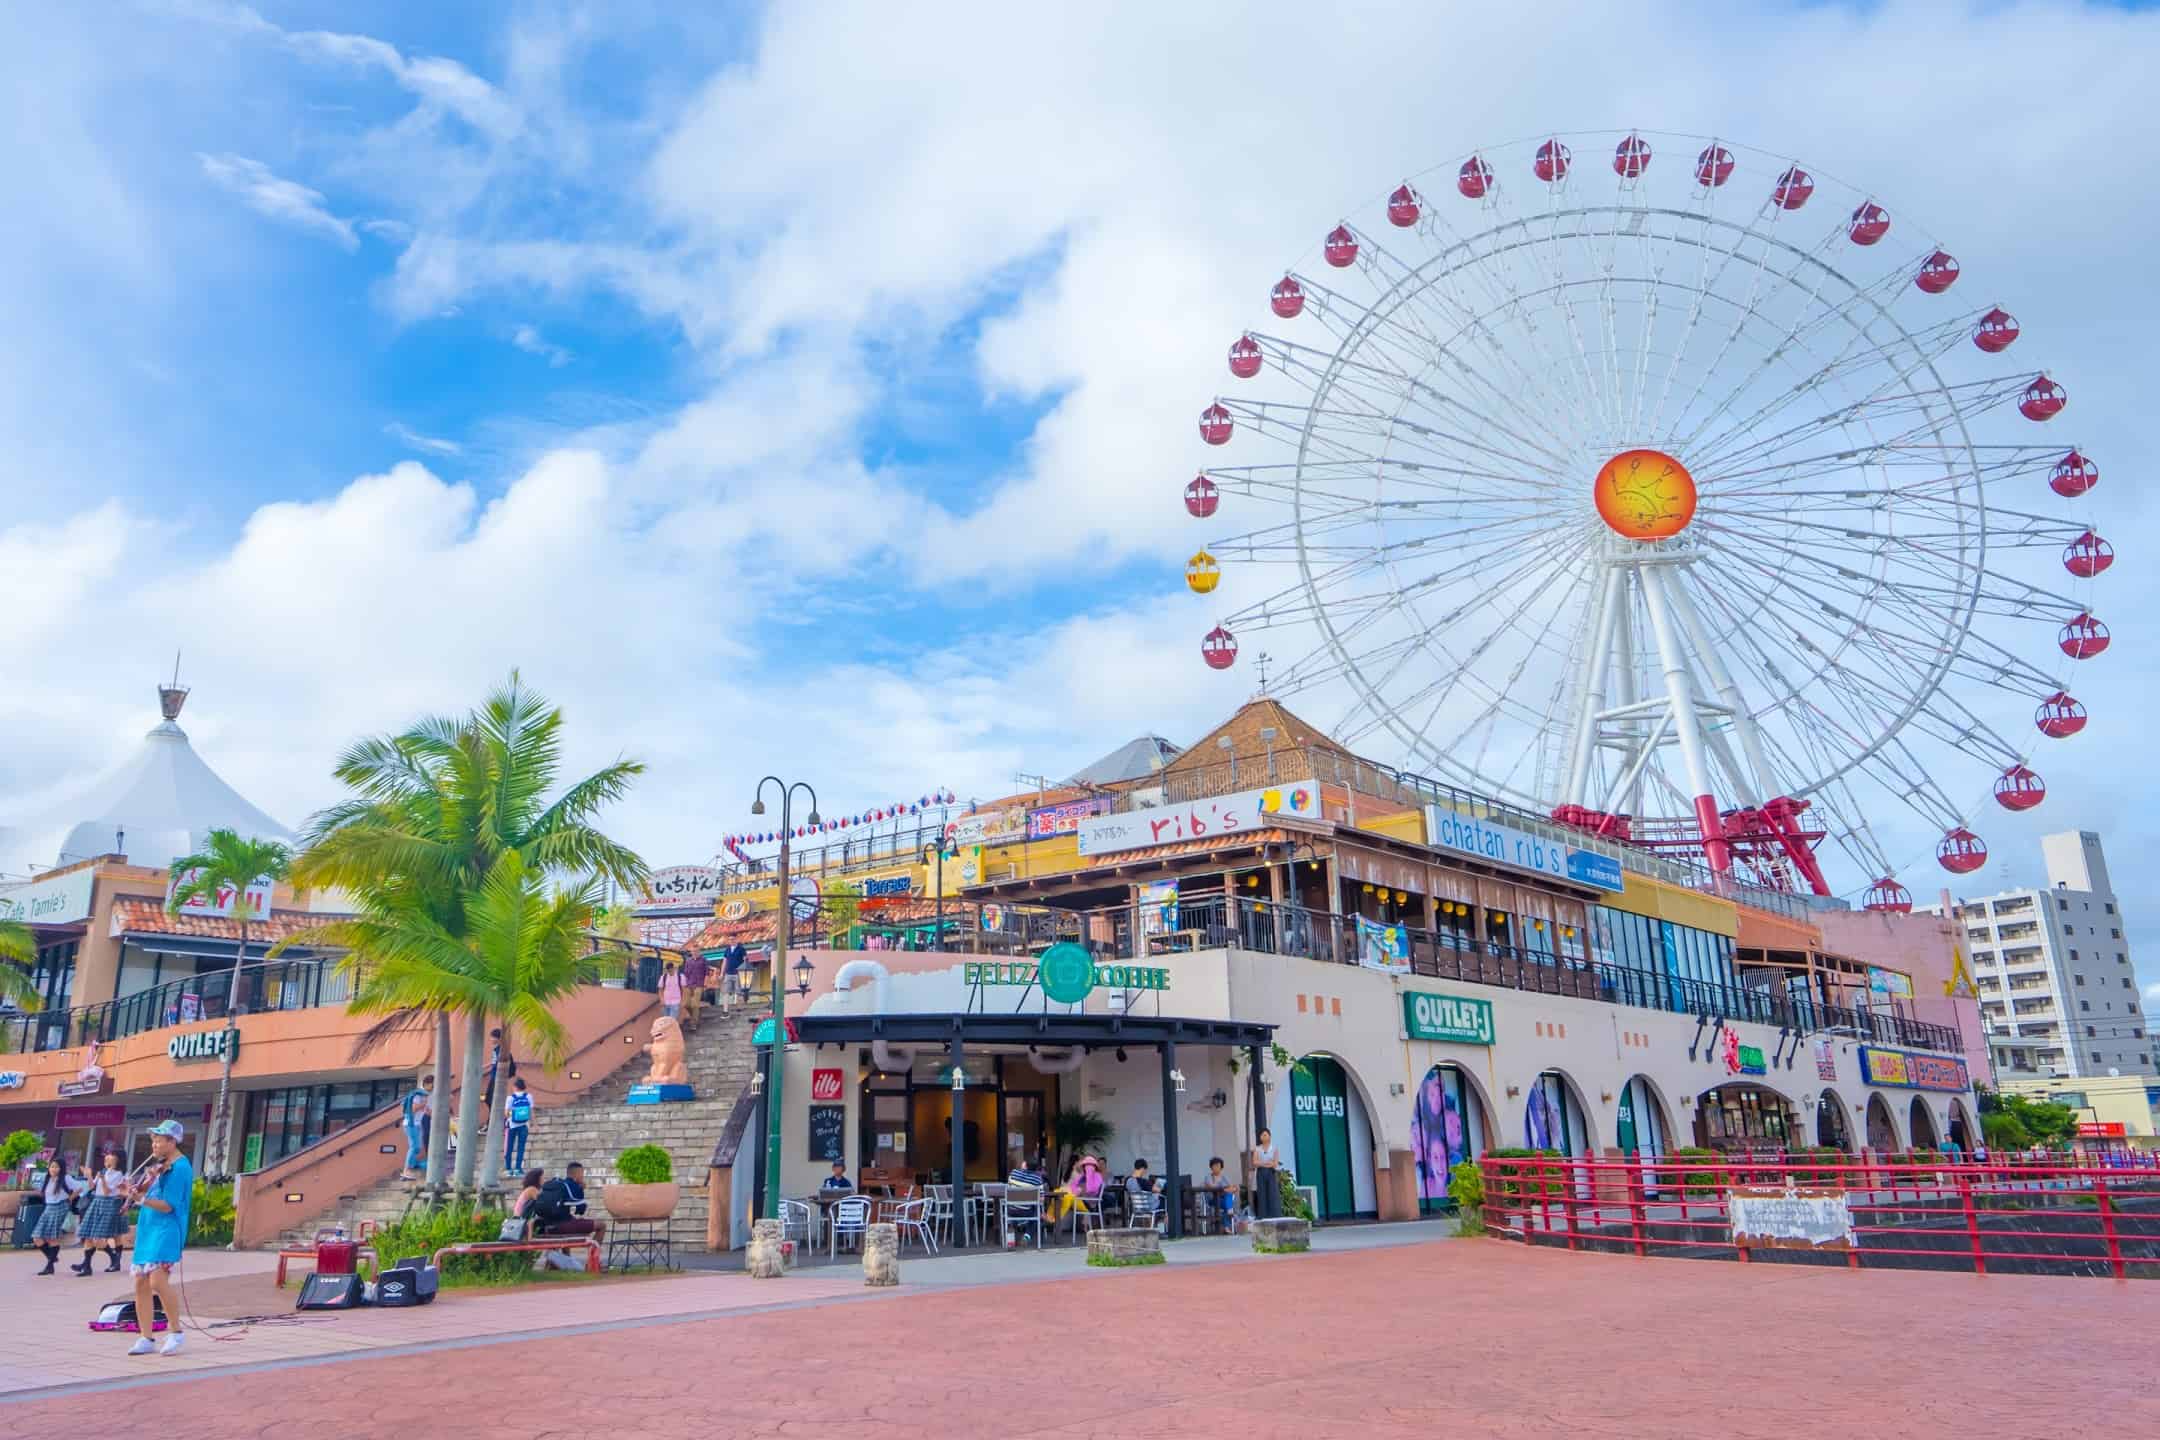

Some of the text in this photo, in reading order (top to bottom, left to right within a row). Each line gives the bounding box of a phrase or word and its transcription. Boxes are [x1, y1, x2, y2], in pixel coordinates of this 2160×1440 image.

[1151, 804, 1239, 842] rib's
[1441, 813, 1560, 873] chatan rib's
[965, 962, 1171, 990] FELIZ COFFEE
[1416, 996, 1491, 1041] OUTLET-J
[815, 1073, 841, 1098] illy
[1295, 1095, 1344, 1118] OUTLET-J
